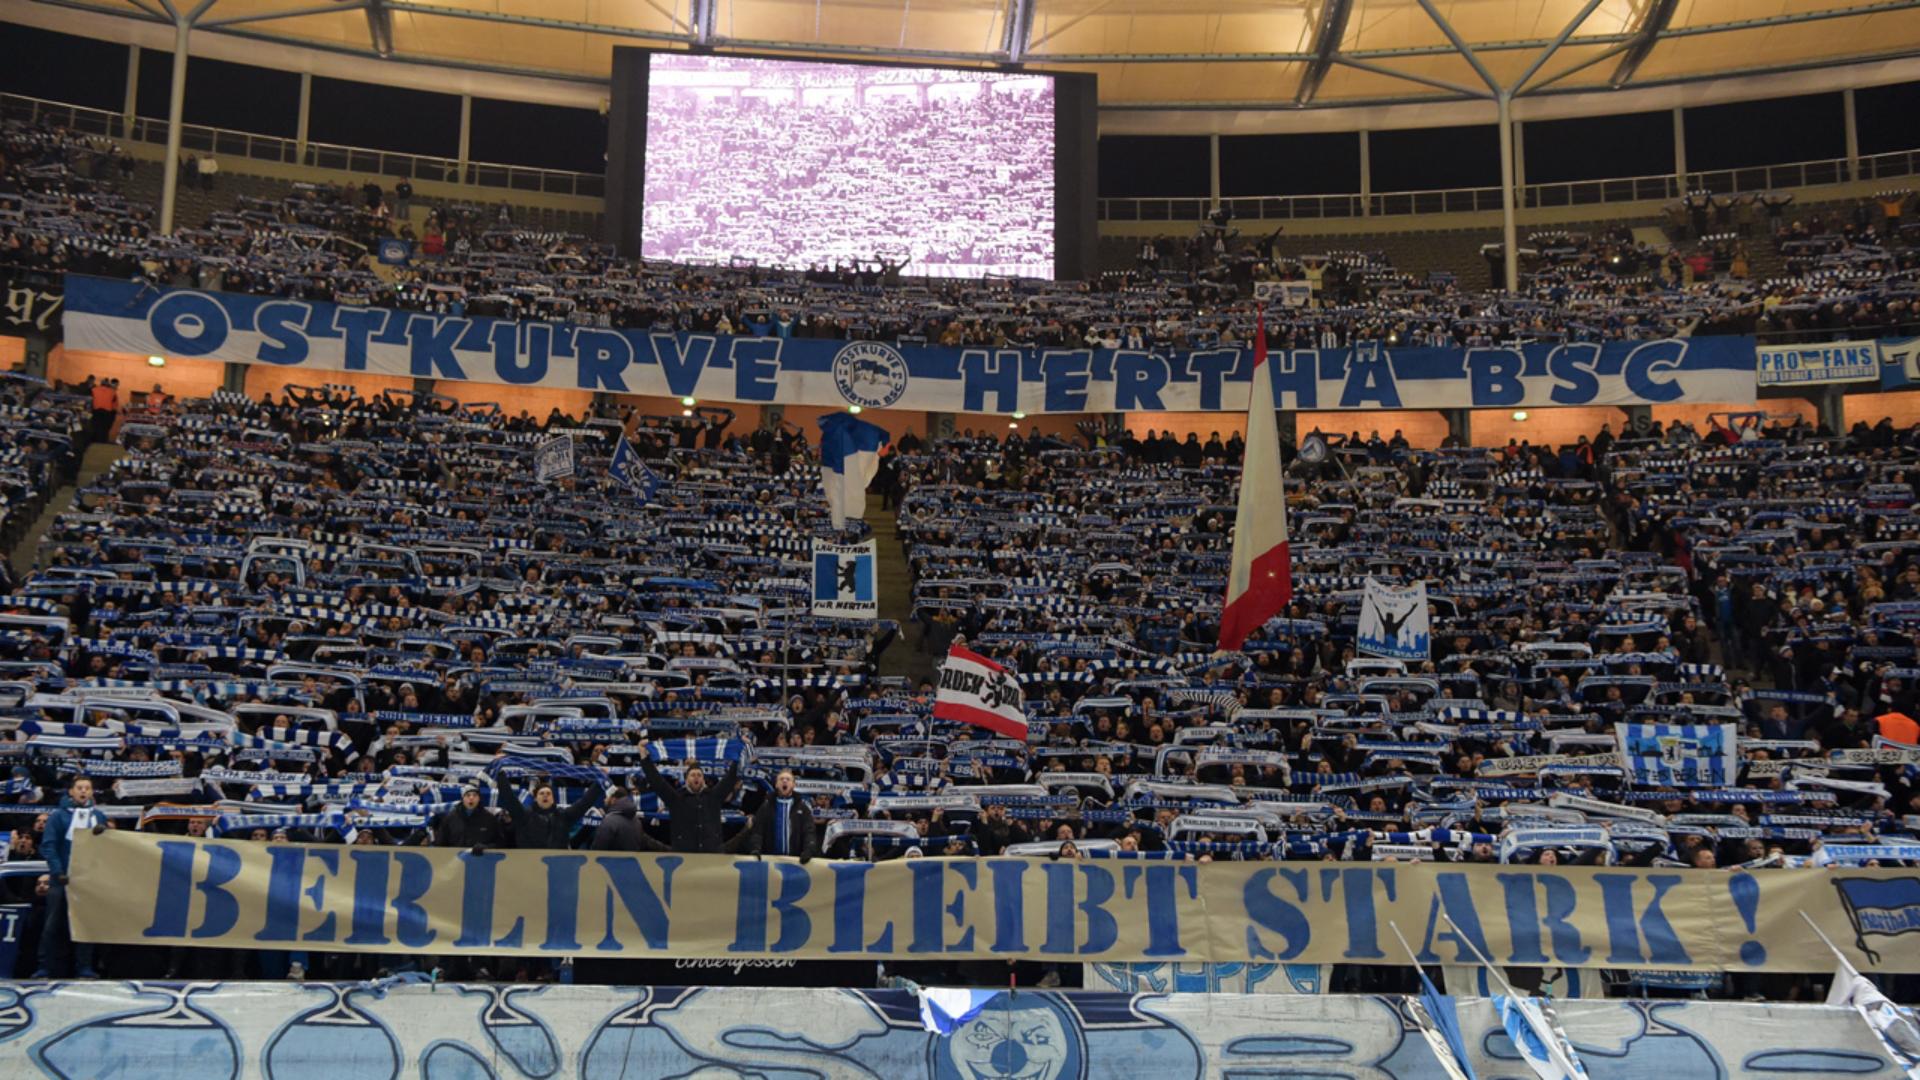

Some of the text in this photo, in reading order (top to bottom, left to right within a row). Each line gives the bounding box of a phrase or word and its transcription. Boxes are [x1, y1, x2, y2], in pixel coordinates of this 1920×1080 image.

[147, 290, 1693, 412] OSTKURVE HERTHA BSC
[841, 344, 900, 368] OSTKURVE
[1761, 352, 1799, 370] PRO
[1823, 347, 1872, 367] FANS
[839, 379, 902, 407] HERTHA BSC
[227, 814, 337, 828] HERTHA
[143, 840, 1767, 967] BERLIN BLEIBT STARK !
